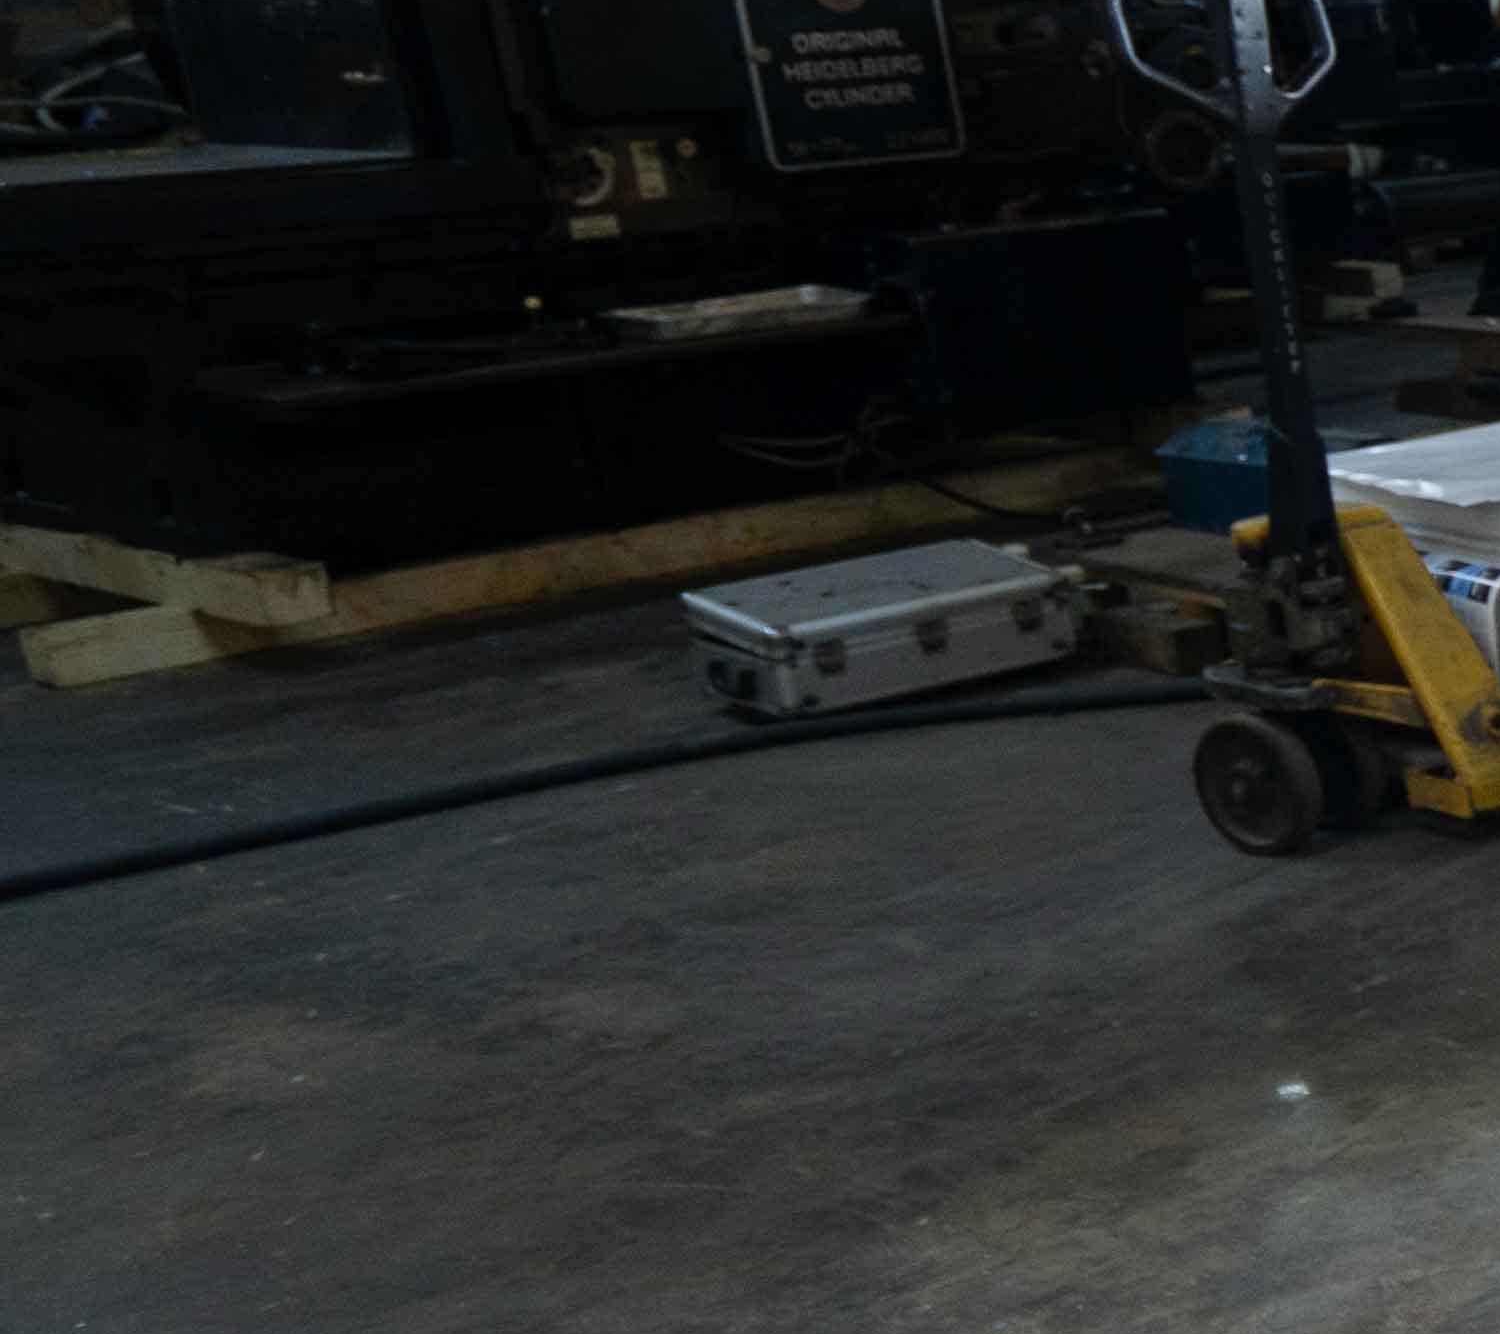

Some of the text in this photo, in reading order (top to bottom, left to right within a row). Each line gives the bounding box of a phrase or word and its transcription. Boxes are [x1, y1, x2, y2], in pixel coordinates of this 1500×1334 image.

[792, 28, 902, 54] ORIGINAL
[782, 54, 926, 82] HEIDELBERG
[804, 82, 915, 108] CYLINDER
